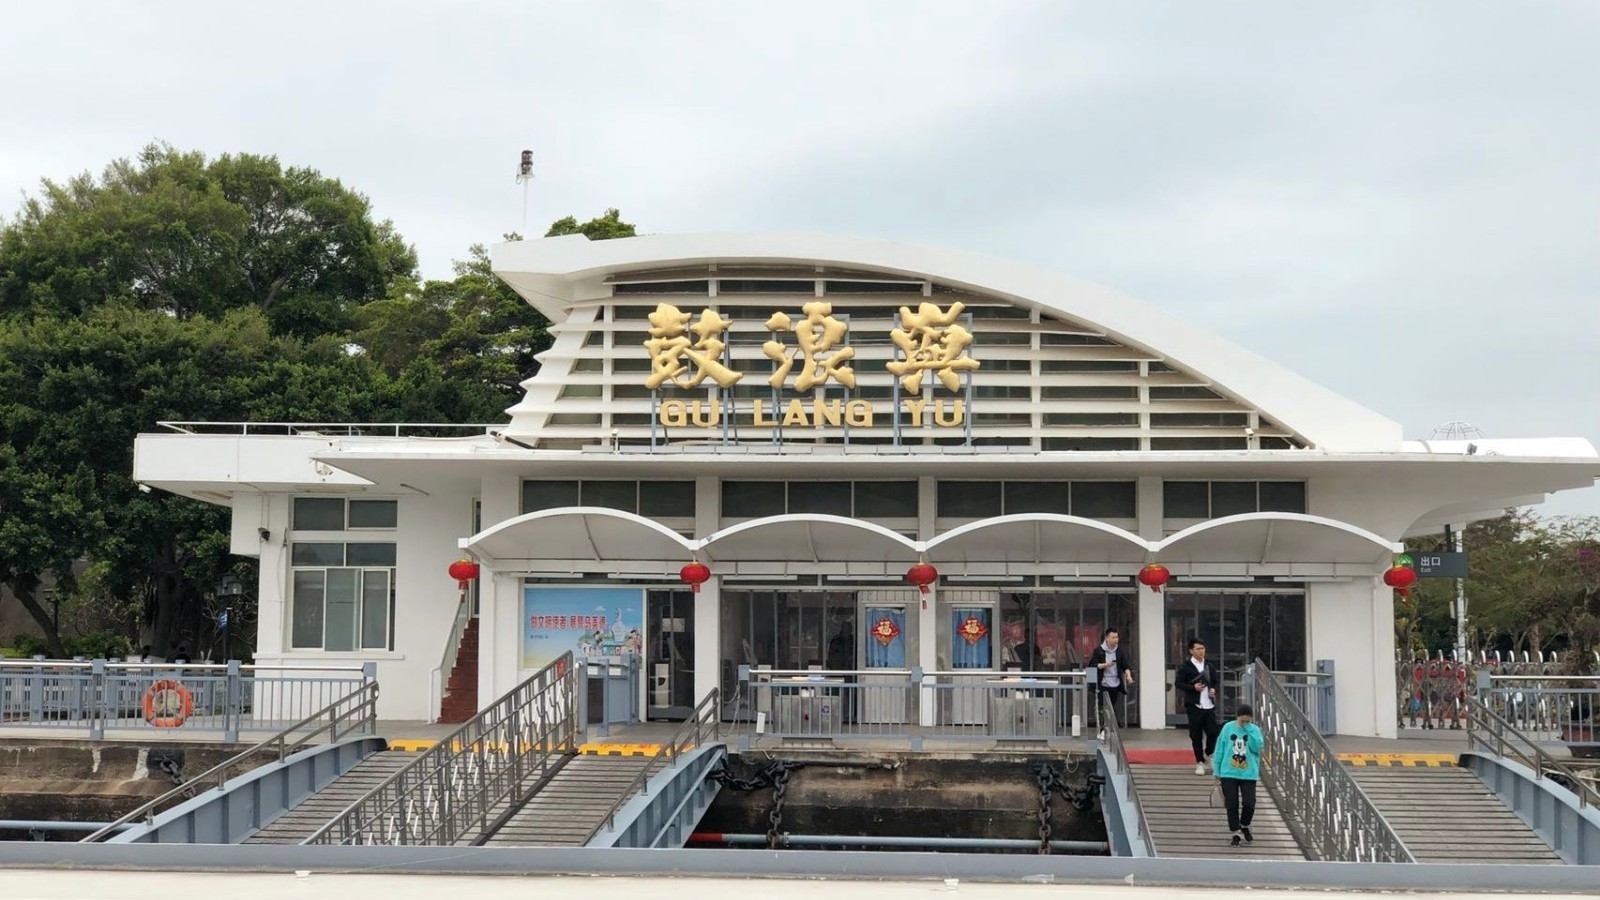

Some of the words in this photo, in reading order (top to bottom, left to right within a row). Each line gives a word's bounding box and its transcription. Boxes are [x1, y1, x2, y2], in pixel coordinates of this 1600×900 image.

[660, 399, 720, 428] GU
[753, 399, 874, 428] LANG
[904, 399, 964, 428] YU
[1420, 556, 1441, 567] 出口
[877, 621, 892, 635] 福
[964, 619, 980, 634] 福
